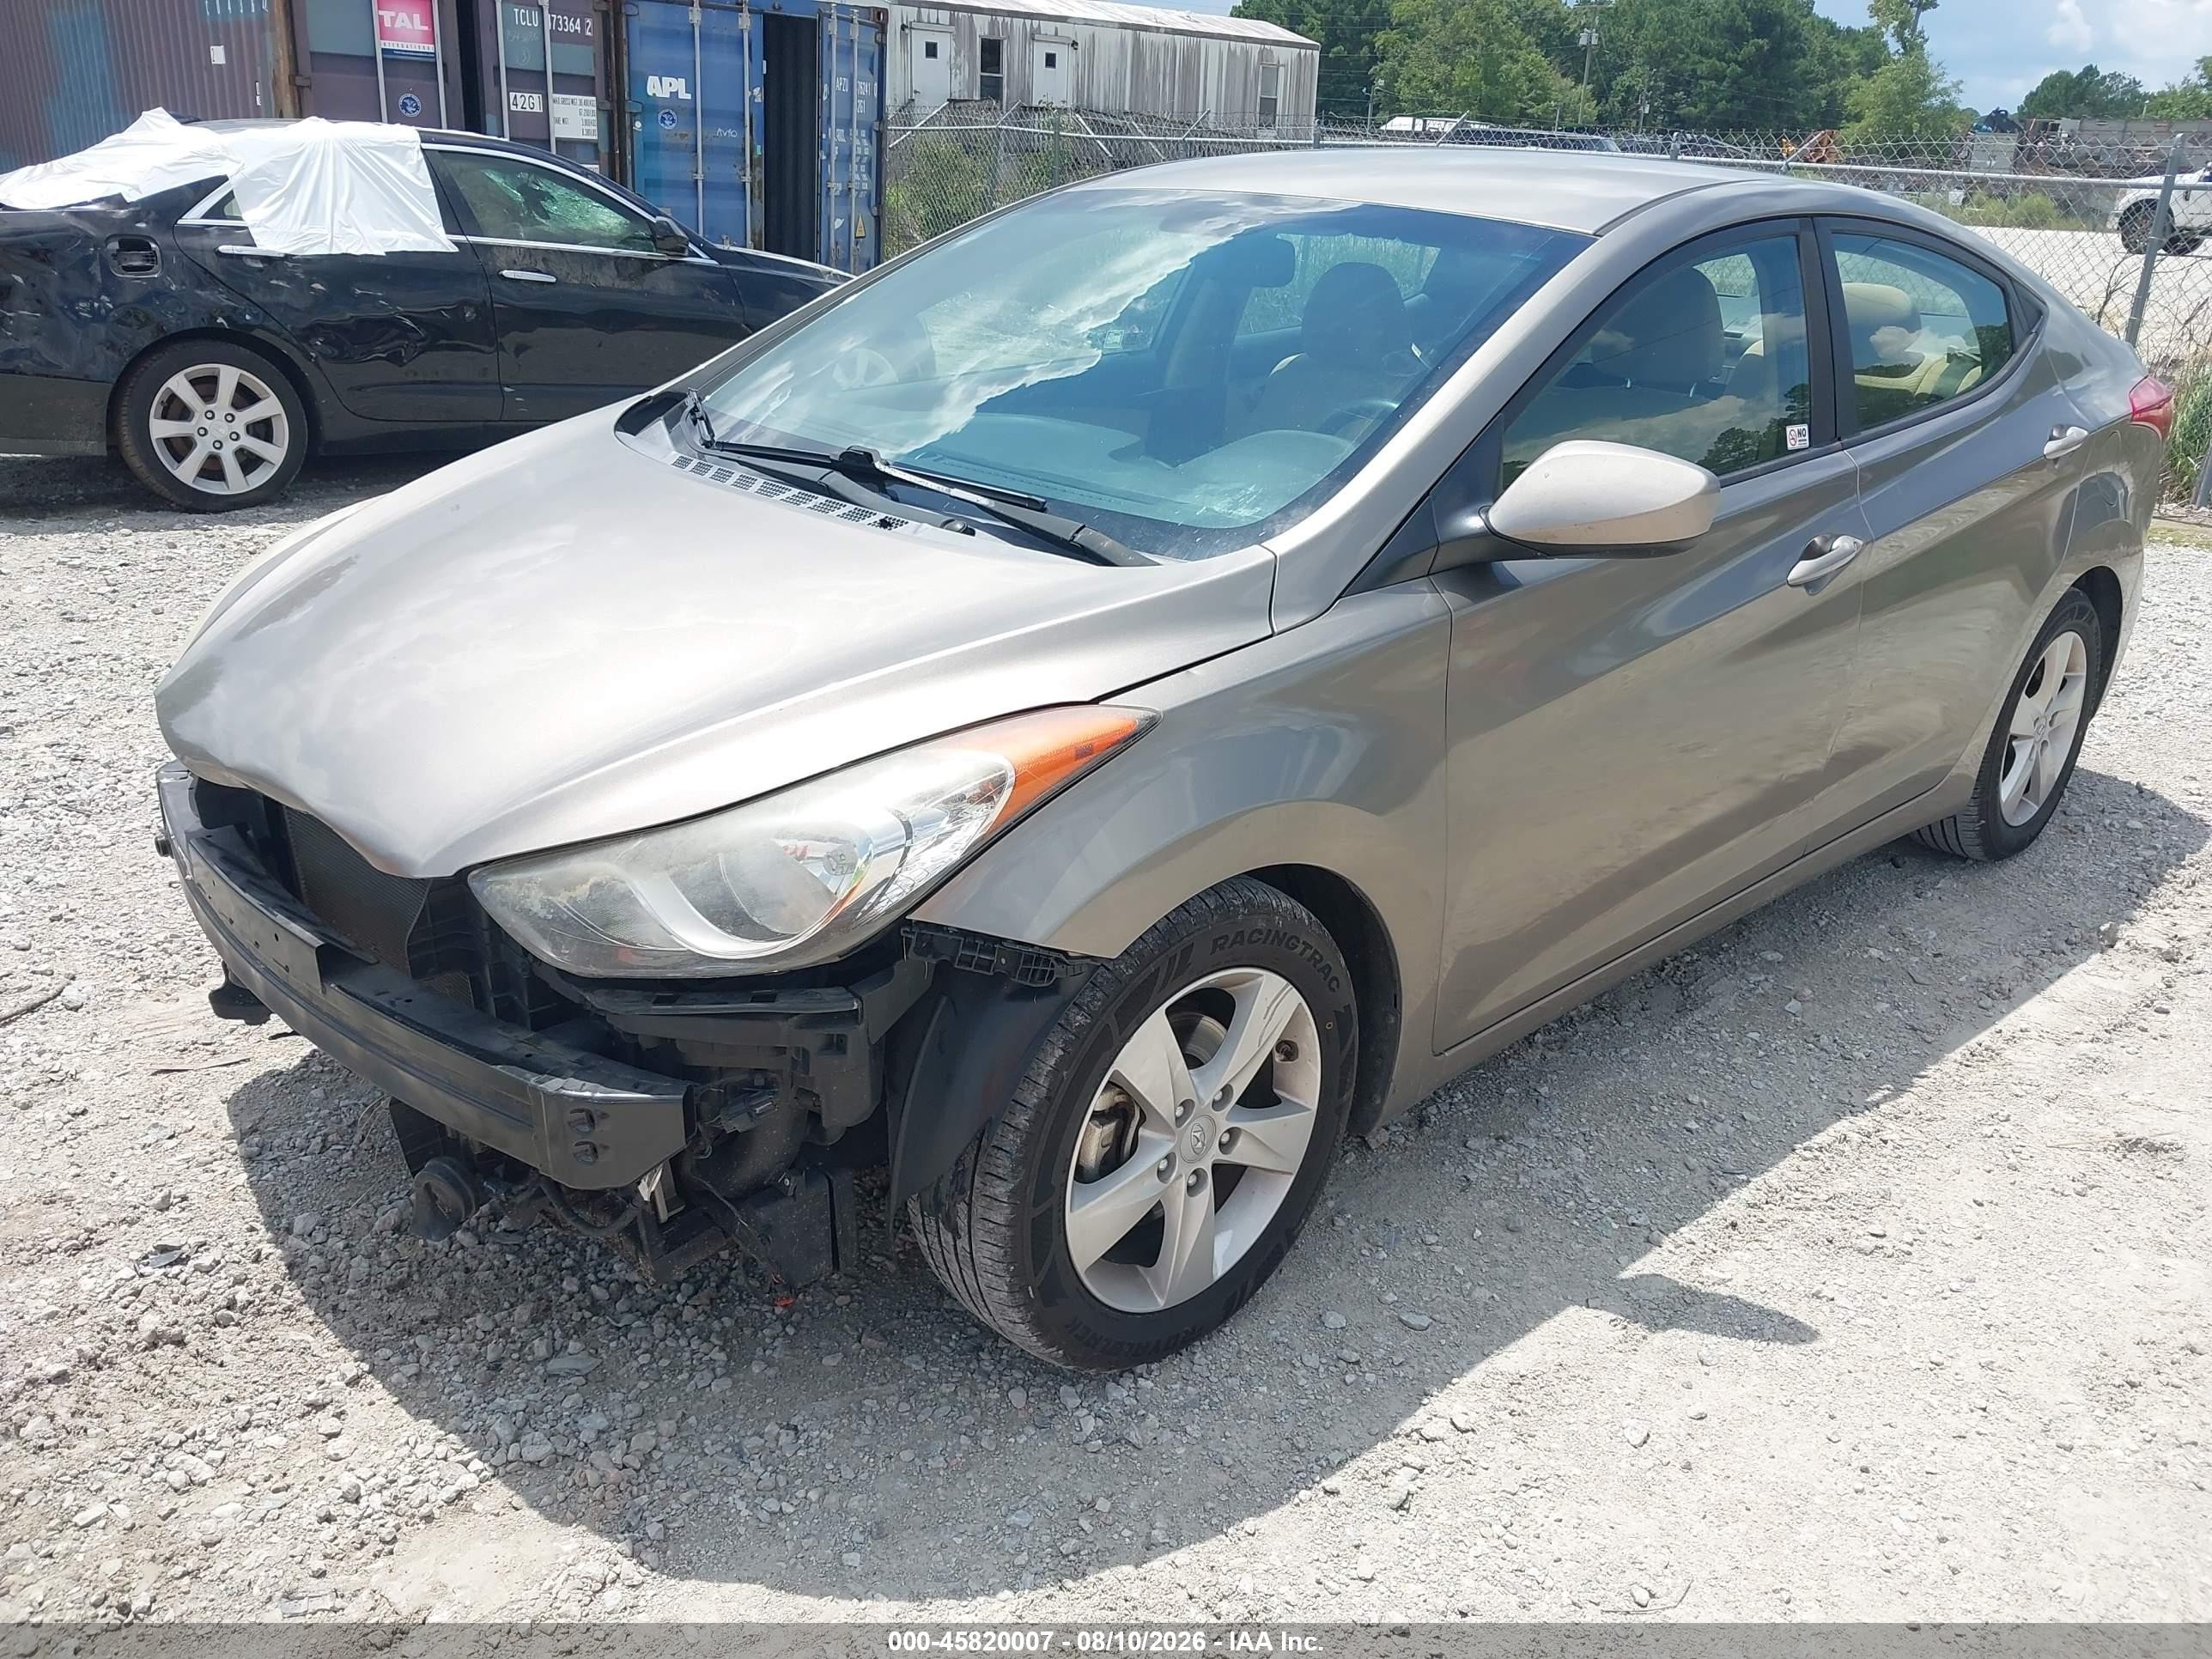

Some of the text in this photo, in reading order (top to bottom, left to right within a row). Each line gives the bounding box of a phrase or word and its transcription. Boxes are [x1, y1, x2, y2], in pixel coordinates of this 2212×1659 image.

[378, 10, 429, 31] TAL
[514, 9, 539, 27] TCLU
[586, 19, 592, 35] 2
[647, 76, 692, 100] APL
[836, 76, 849, 92] APZU
[512, 94, 542, 111] 42G1
[1797, 428, 1806, 438] NO
[1210, 928, 1340, 993] RACINGTRAC
